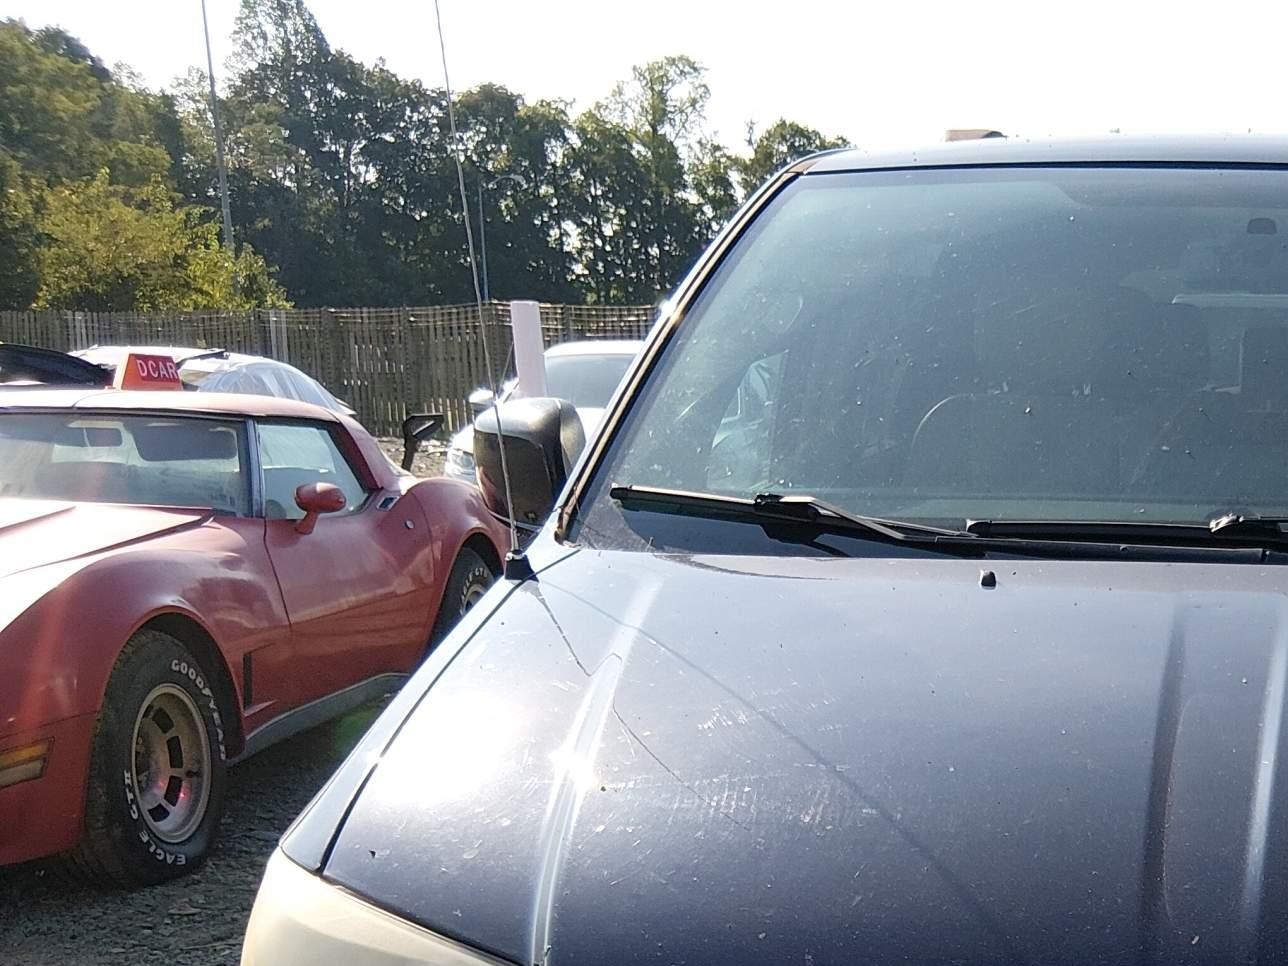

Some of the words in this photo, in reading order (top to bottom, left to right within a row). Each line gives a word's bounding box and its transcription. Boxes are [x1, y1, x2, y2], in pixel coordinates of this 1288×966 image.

[136, 359, 178, 379] DCAR
[171, 659, 227, 761] GOODYEAR
[138, 829, 187, 866] EAGLE
